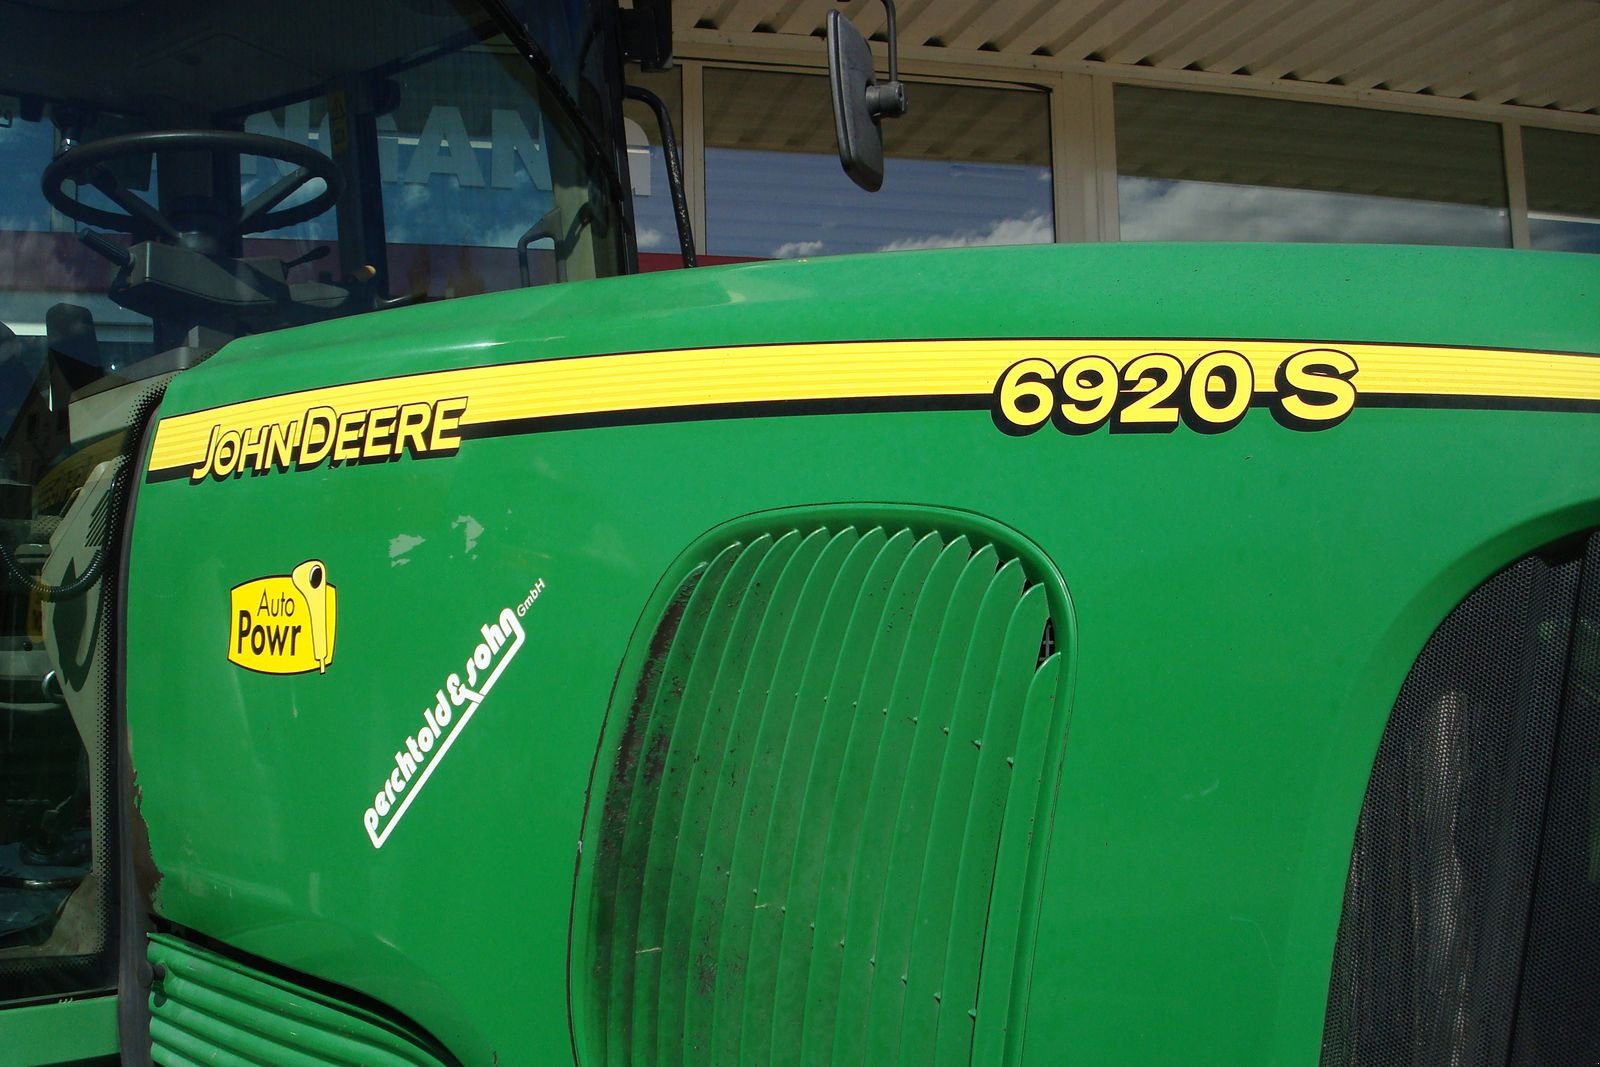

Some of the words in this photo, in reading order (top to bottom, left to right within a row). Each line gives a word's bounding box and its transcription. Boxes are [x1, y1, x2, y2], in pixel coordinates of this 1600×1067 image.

[991, 350, 1255, 437] 6920
[1269, 348, 1360, 432] S
[189, 420, 299, 485] JOHN
[295, 396, 469, 472] DEERE
[237, 609, 303, 657] Powr
[256, 588, 296, 617] Auto
[363, 689, 452, 848] perchtold
[446, 673, 485, 705] &
[466, 607, 526, 688] sohn
[516, 577, 546, 618] GmbH
